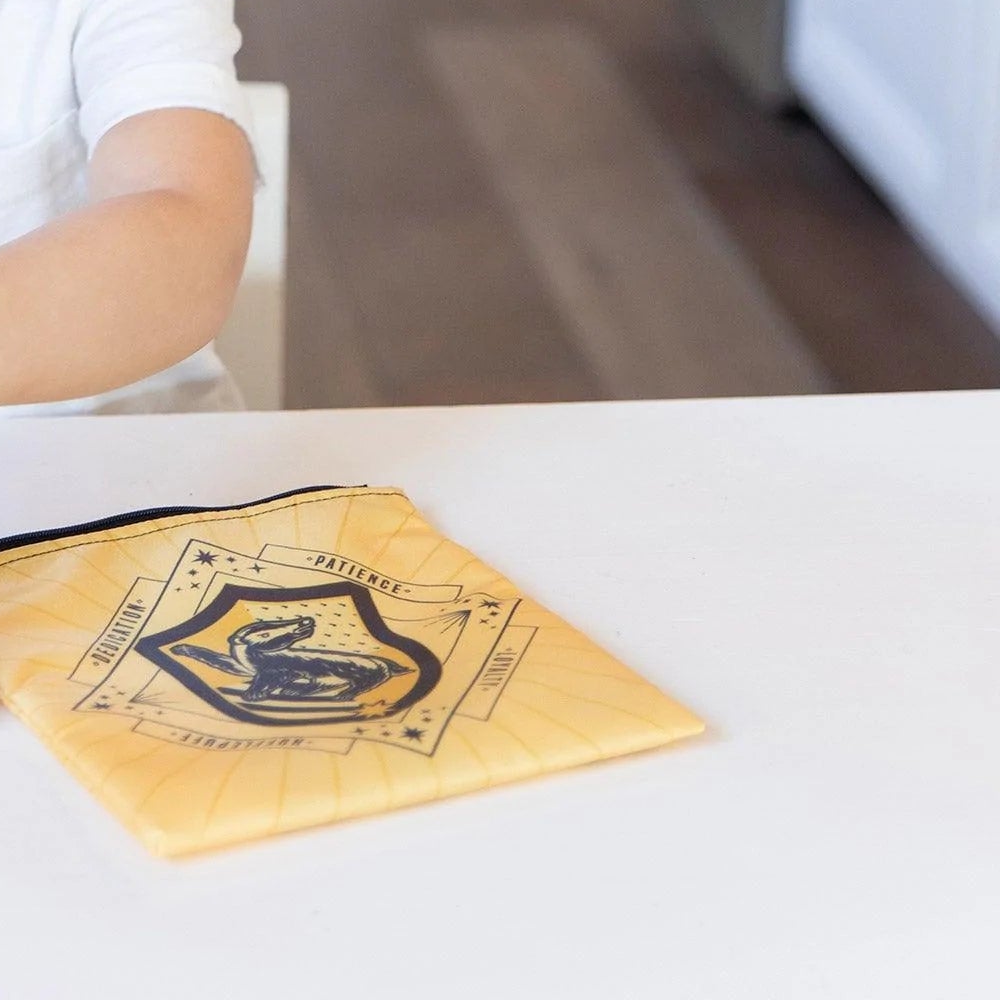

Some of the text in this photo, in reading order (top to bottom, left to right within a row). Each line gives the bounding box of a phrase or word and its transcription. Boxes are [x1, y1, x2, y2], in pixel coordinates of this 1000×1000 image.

[314, 555, 402, 594] PATIENCE
[91, 603, 146, 664] DEDICATION
[477, 652, 518, 687] LOYALTY
